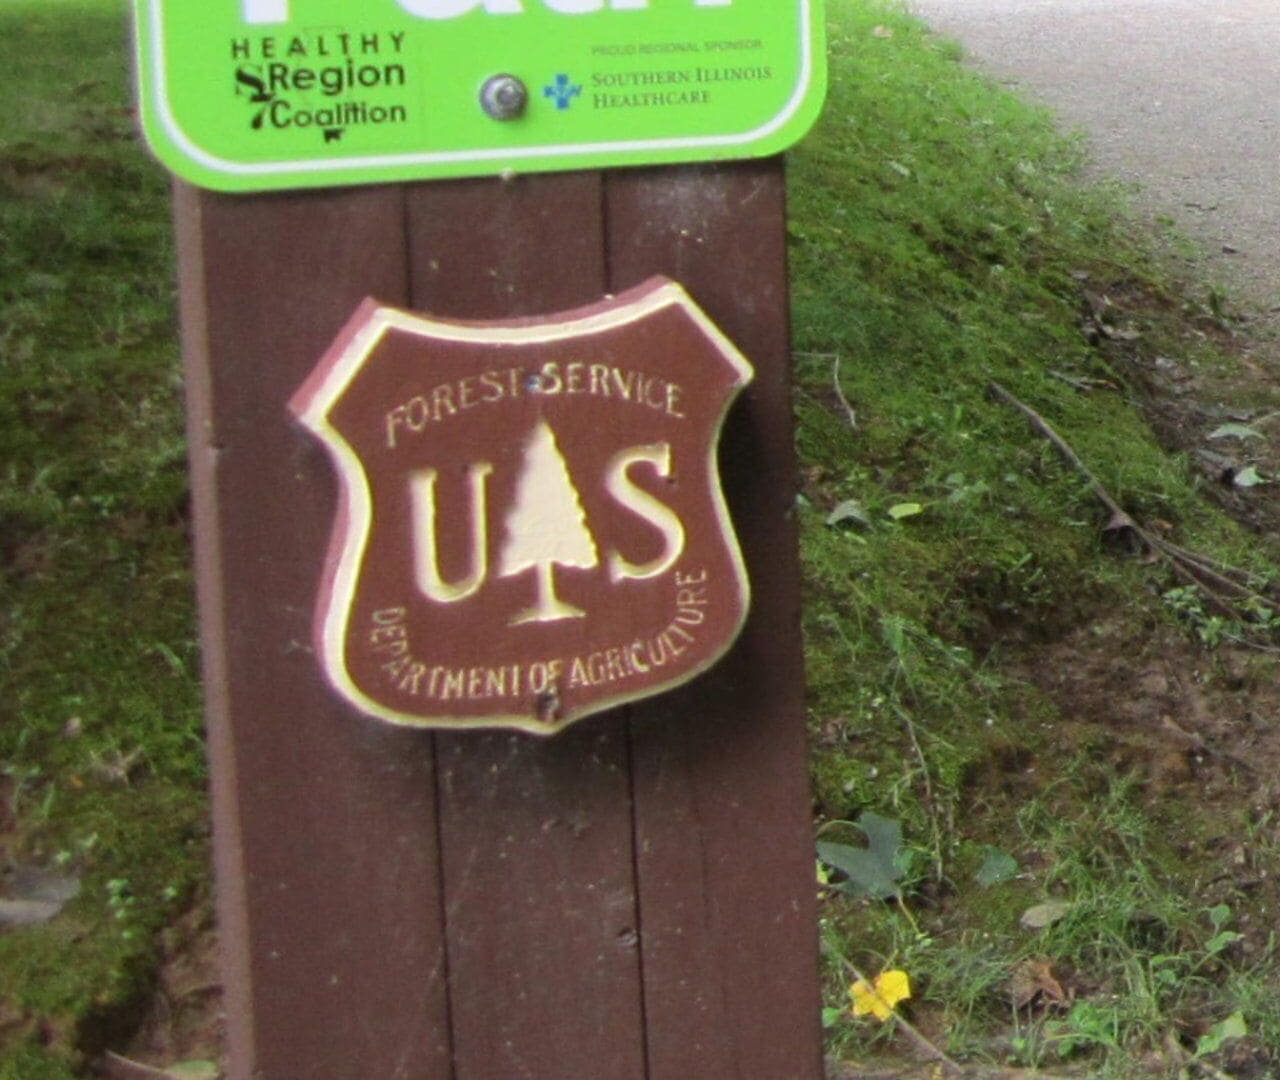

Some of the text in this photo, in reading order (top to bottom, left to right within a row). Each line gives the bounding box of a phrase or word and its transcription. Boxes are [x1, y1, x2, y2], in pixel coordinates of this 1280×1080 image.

[231, 31, 405, 60] HEALTHY
[638, 41, 699, 55] REGIONAL
[703, 38, 764, 52] SPONSOR
[269, 59, 406, 97] Region
[591, 66, 772, 88] SOUTHERN ILLINOIS
[270, 99, 407, 129] Coalition
[592, 90, 711, 109] HEALTHCARE
[385, 362, 685, 448] FOREST SERVICE
[370, 567, 710, 701] DEPARTMENT OF AGRICULTURE
